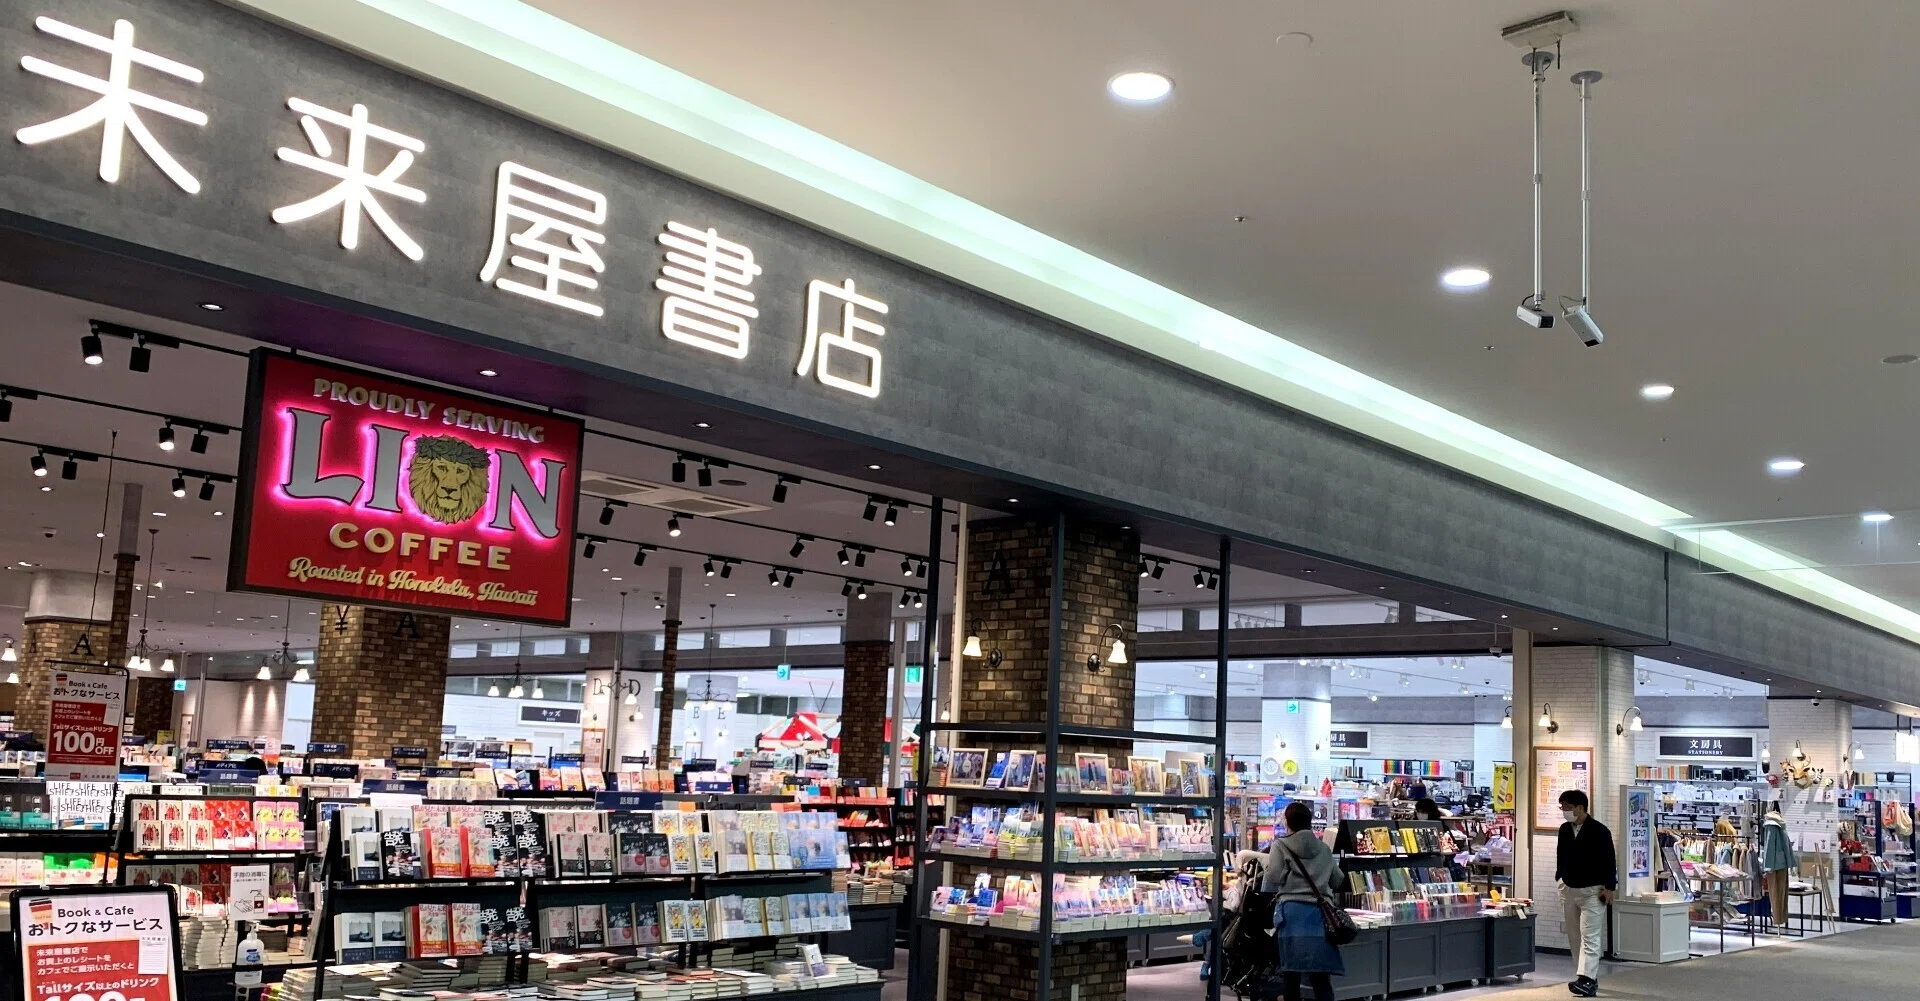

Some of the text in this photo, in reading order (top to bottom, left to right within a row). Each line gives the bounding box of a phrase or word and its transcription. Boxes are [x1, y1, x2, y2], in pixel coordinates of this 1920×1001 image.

[16, 15, 889, 398] 未来屋書店
[313, 378, 545, 444] PROUDLY SERVING
[329, 522, 511, 571] COFFEE
[288, 556, 539, 606] Roasted in Honolulu, Hawaii
[392, 611, 421, 639] A
[70, 633, 94, 656] A
[53, 688, 120, 700] おトクなサービス
[628, 679, 641, 696] D
[541, 709, 561, 717] キッズ
[693, 706, 700, 719] E
[717, 707, 726, 720] E
[53, 731, 95, 753] 100
[95, 747, 114, 755] OFF
[1689, 739, 1722, 750] 文房具
[620, 796, 640, 805] 話題書
[58, 908, 91, 918] Book
[104, 906, 134, 916] Cafe
[29, 917, 163, 937] おトクなサービス
[36, 946, 89, 957] 未来屋書店で
[37, 955, 111, 966] お買上のレシートを
[37, 962, 135, 976] カフェでご提示いただくと
[37, 977, 160, 995] Tallサイズ以上のドリンク
